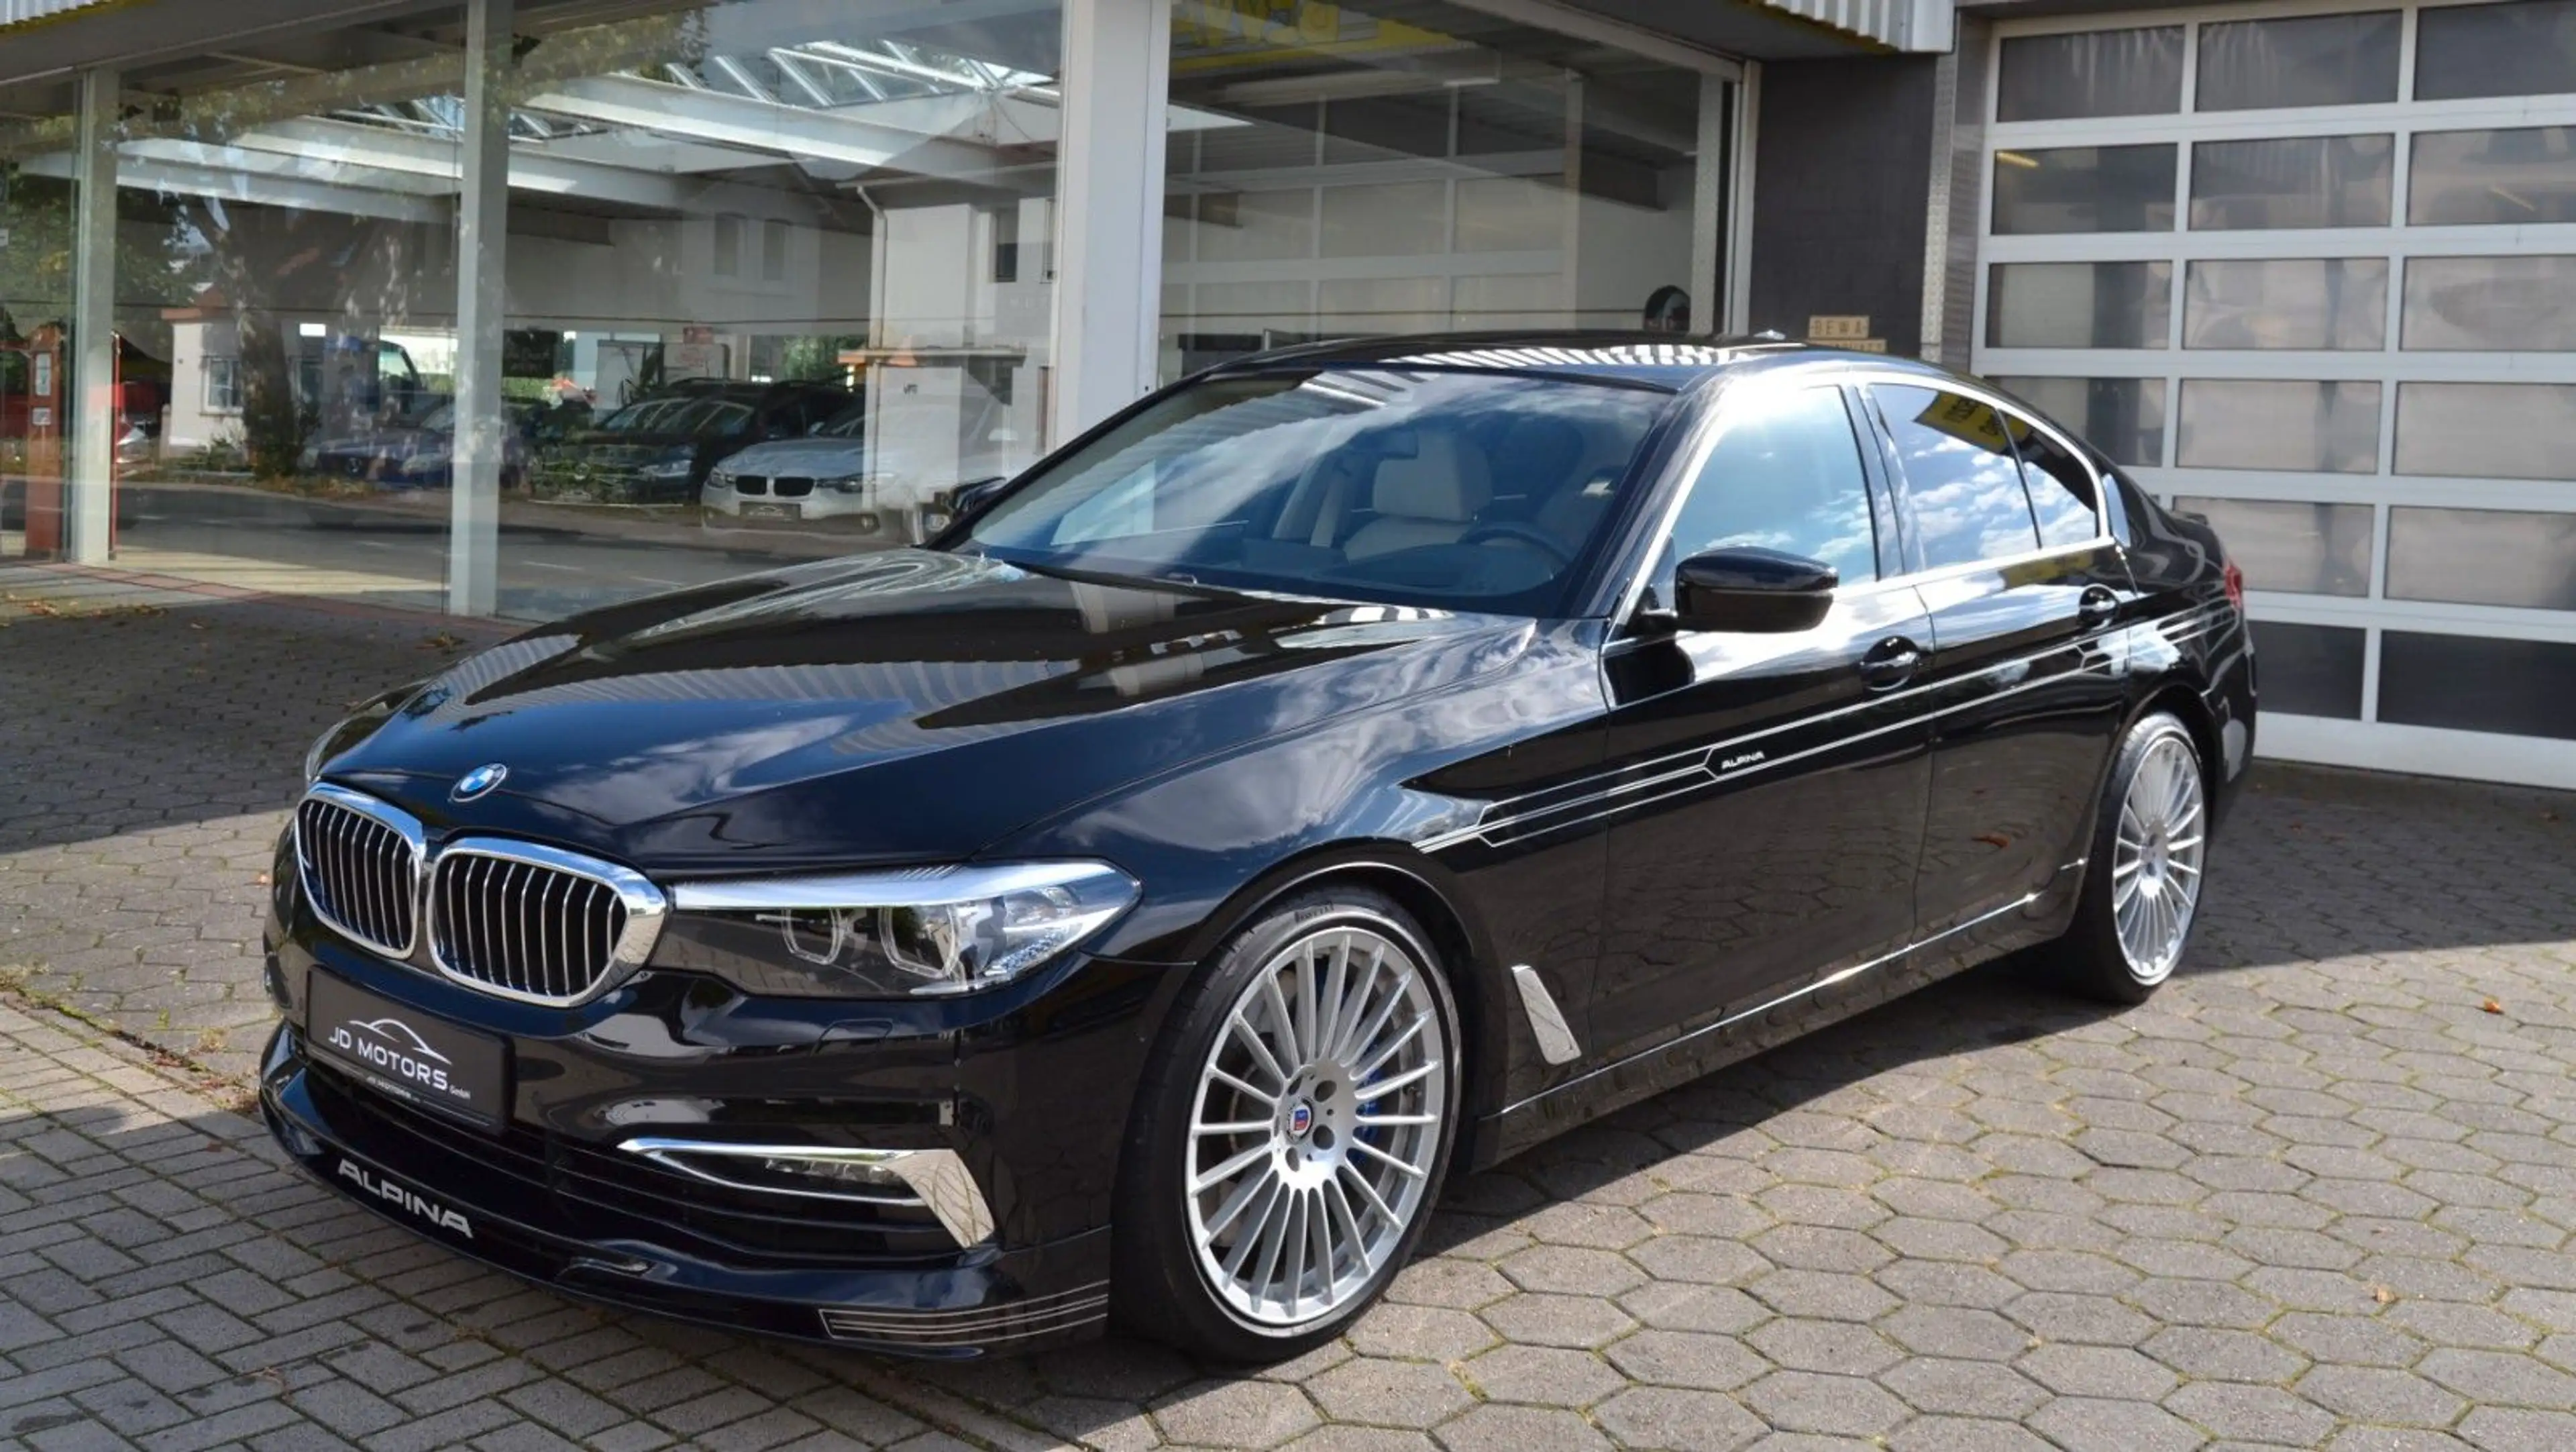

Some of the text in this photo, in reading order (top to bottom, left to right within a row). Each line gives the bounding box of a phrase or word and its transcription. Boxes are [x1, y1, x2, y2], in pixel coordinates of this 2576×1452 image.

[1721, 750, 1765, 770] ALPINA
[328, 1026, 352, 1050] JD
[358, 1037, 448, 1091] MOTORS
[338, 1158, 474, 1239] ALPINA
